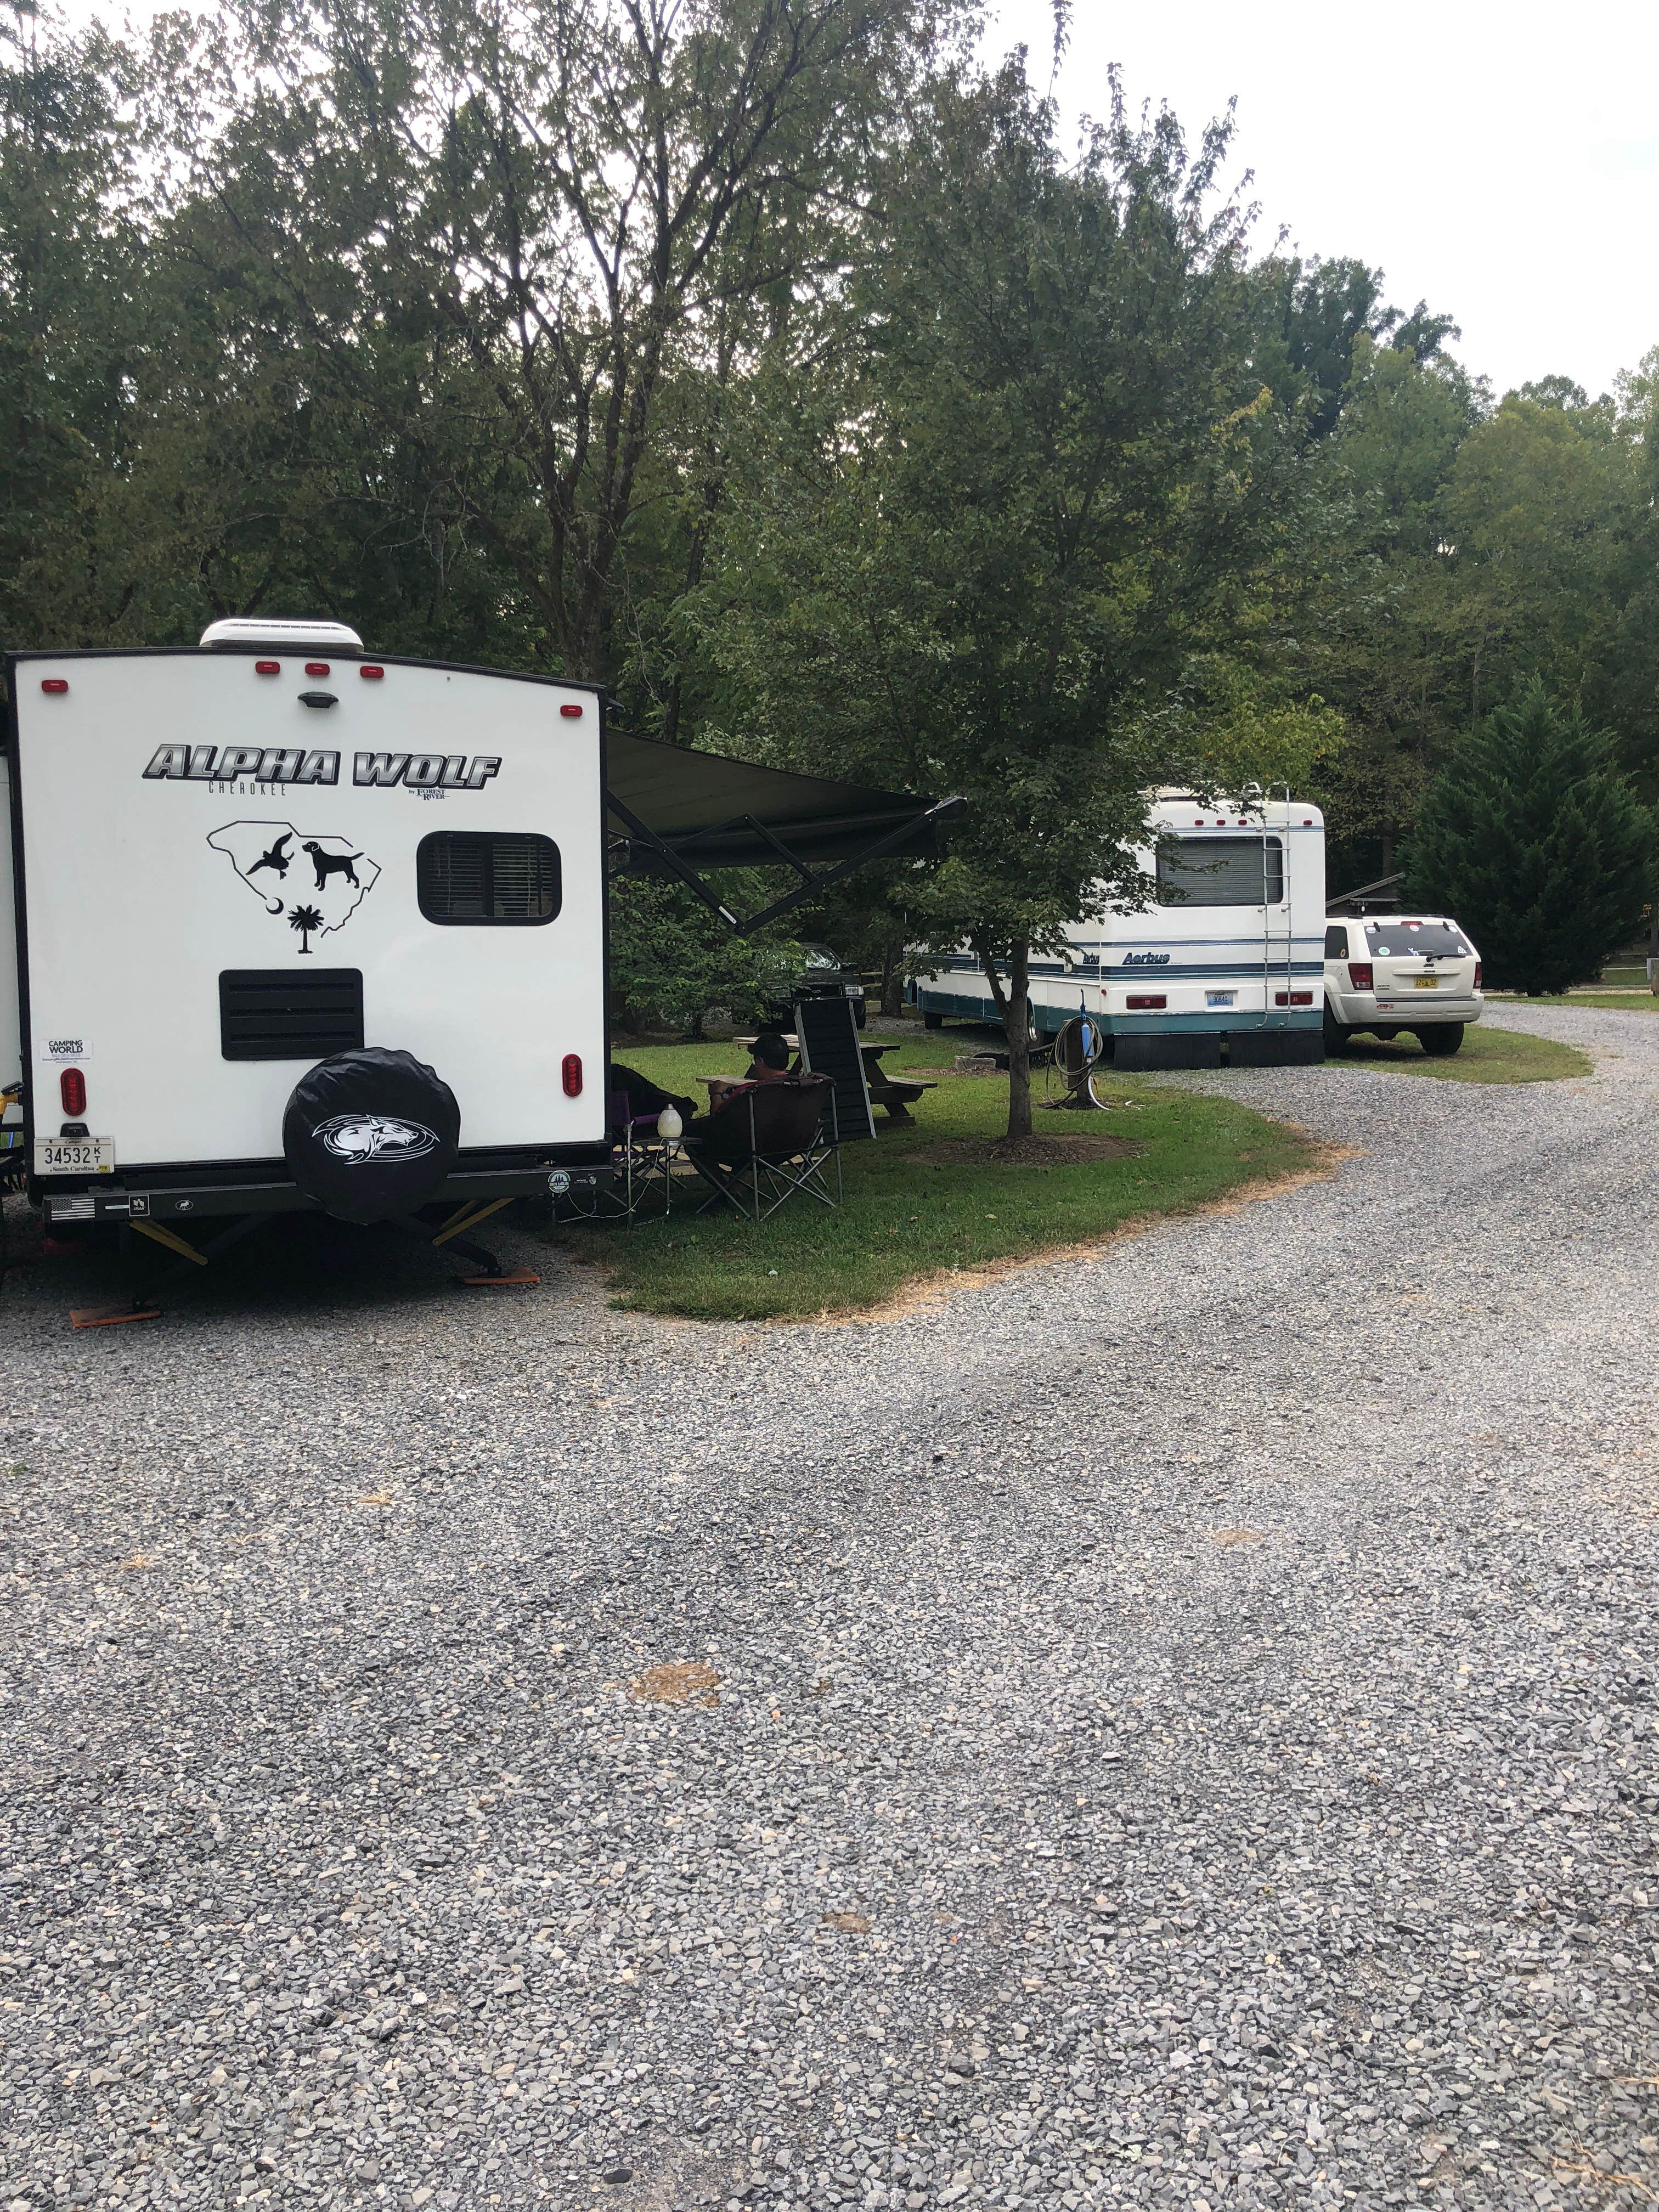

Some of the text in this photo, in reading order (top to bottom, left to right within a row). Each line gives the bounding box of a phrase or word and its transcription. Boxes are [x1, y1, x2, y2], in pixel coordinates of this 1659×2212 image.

[142, 744, 503, 789] ALPHA WOLF
[208, 781, 286, 795] CHEROKEE
[1121, 952, 1170, 965] Aerbus
[44, 1147, 91, 1164] 34532
